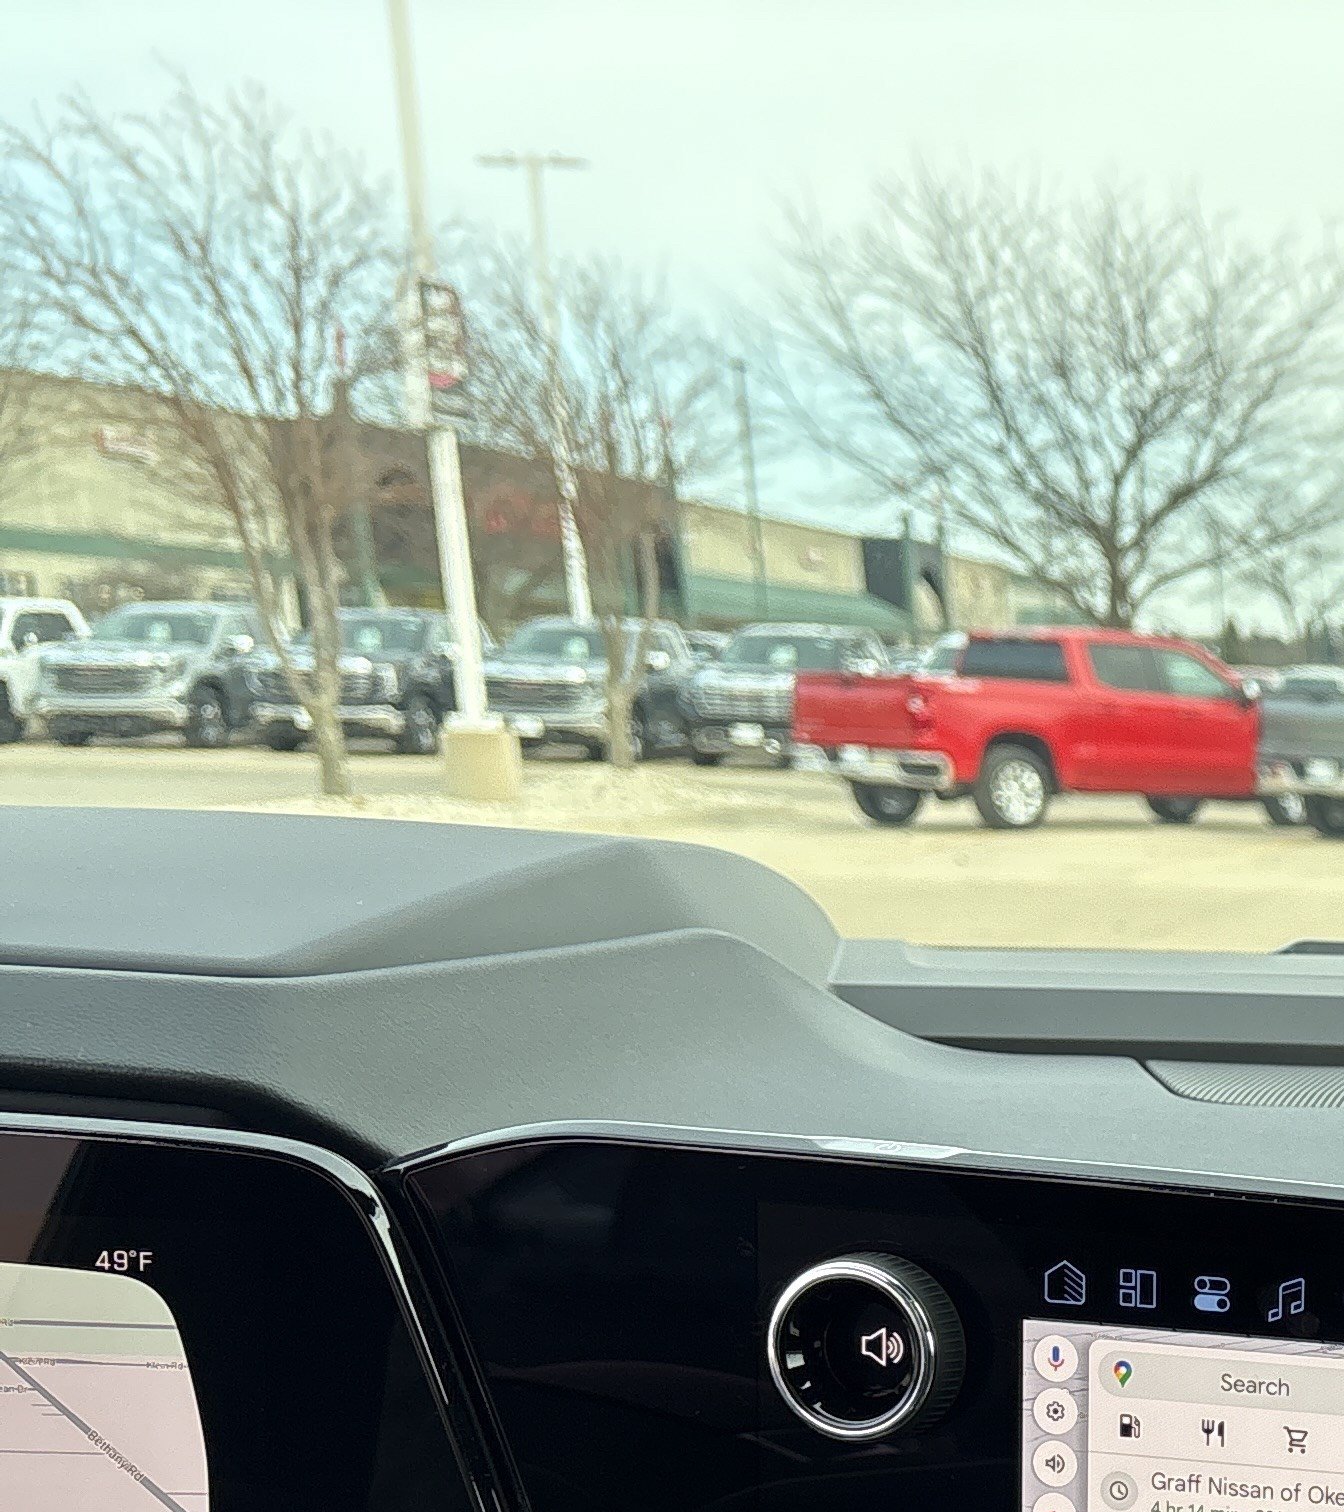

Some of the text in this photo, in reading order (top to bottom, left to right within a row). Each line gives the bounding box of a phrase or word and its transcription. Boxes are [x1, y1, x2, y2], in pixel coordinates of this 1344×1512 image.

[95, 1250, 153, 1272] 49°F
[1220, 1374, 1290, 1397] Search
[87, 1429, 145, 1483] Bethany Rd
[1151, 1472, 1200, 1495] Graff
[1208, 1477, 1274, 1501] Nissan
[1280, 1482, 1301, 1503] of
